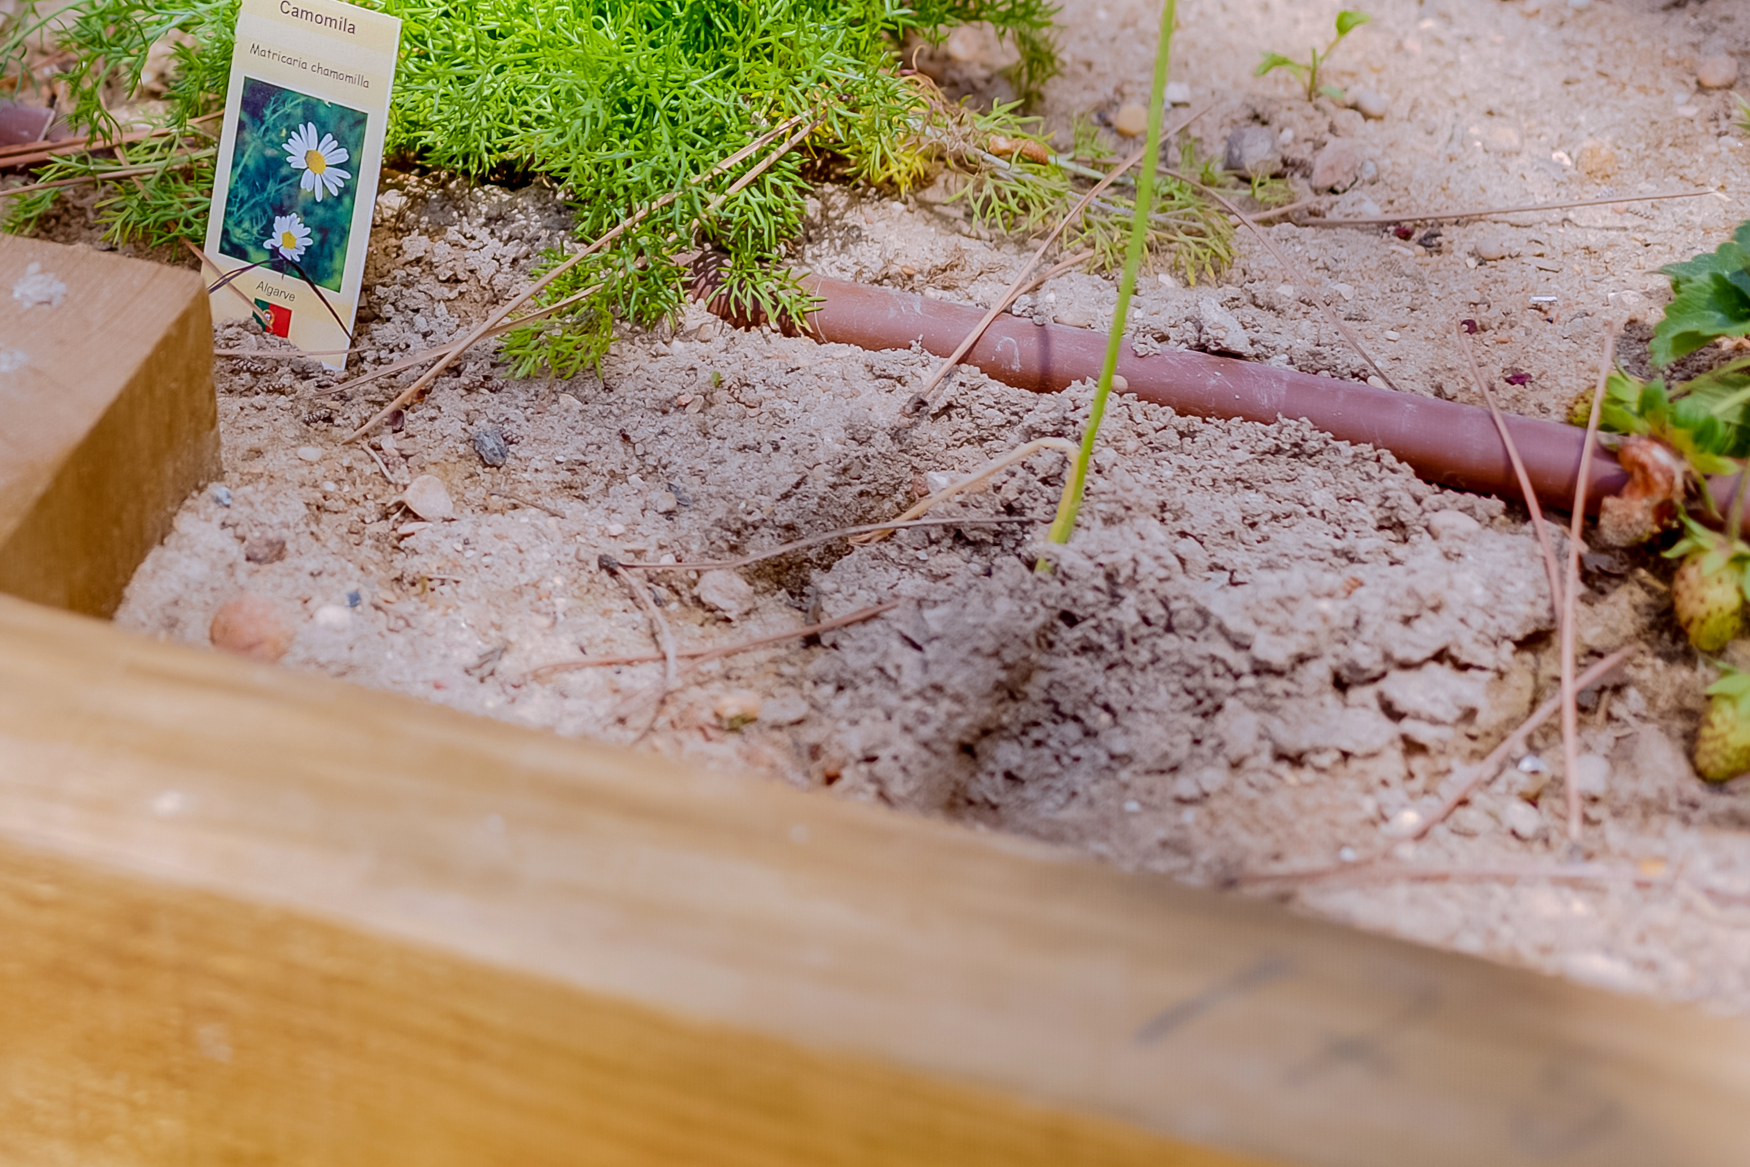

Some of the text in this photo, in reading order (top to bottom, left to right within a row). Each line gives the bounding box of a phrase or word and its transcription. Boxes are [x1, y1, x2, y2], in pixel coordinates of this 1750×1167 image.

[280, 0, 356, 35] Camomila
[249, 43, 370, 89] Matricaria chamomilla
[256, 280, 296, 302] Algarve
